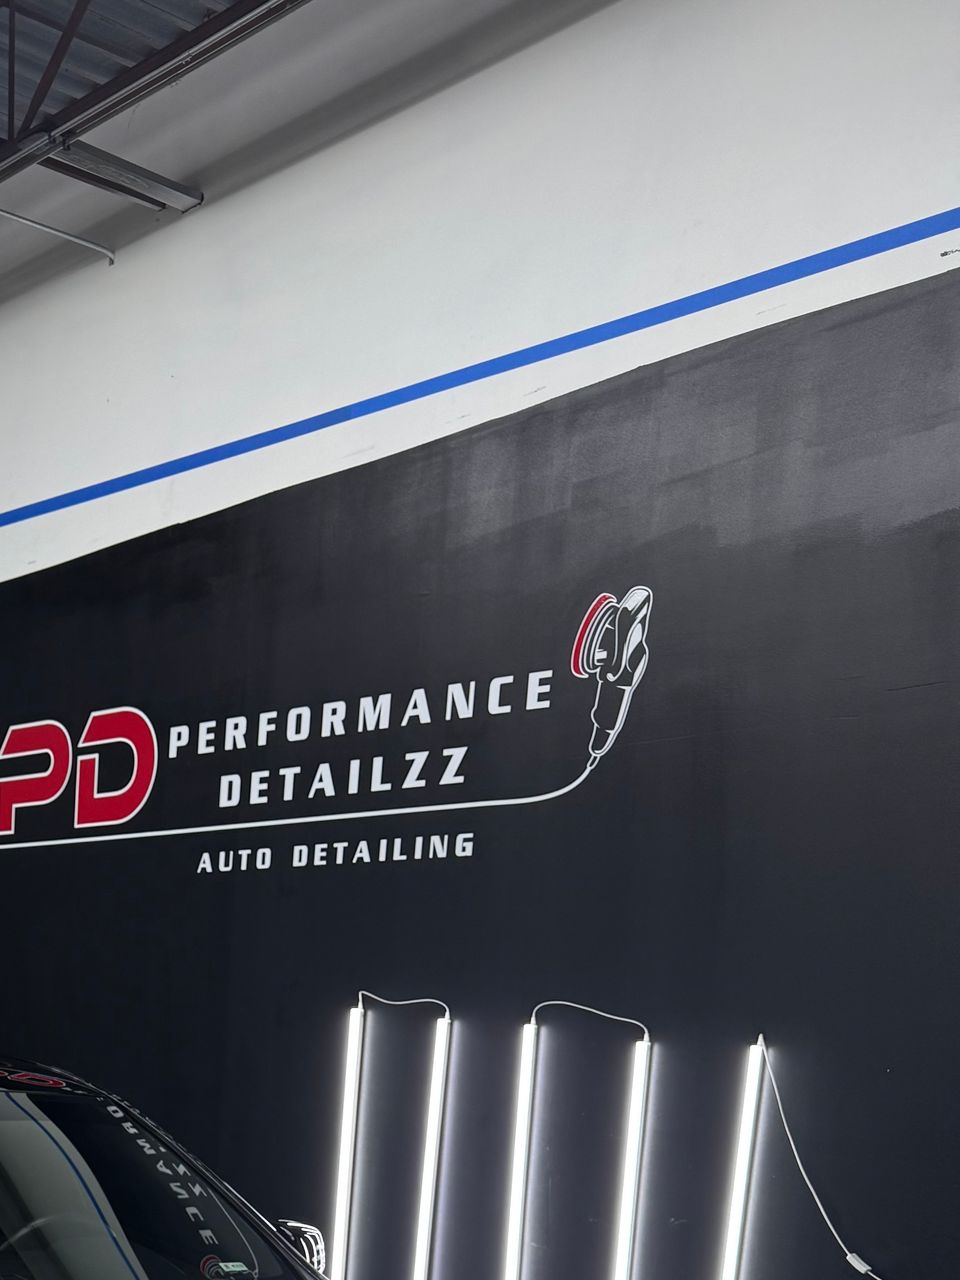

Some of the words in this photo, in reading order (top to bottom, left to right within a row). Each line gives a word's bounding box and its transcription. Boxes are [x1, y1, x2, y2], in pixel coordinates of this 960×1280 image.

[168, 669, 554, 759] PERFORMANCE
[218, 746, 469, 808] DETAILZZ
[196, 847, 272, 874] AUTO
[292, 832, 474, 868] DETAILING
